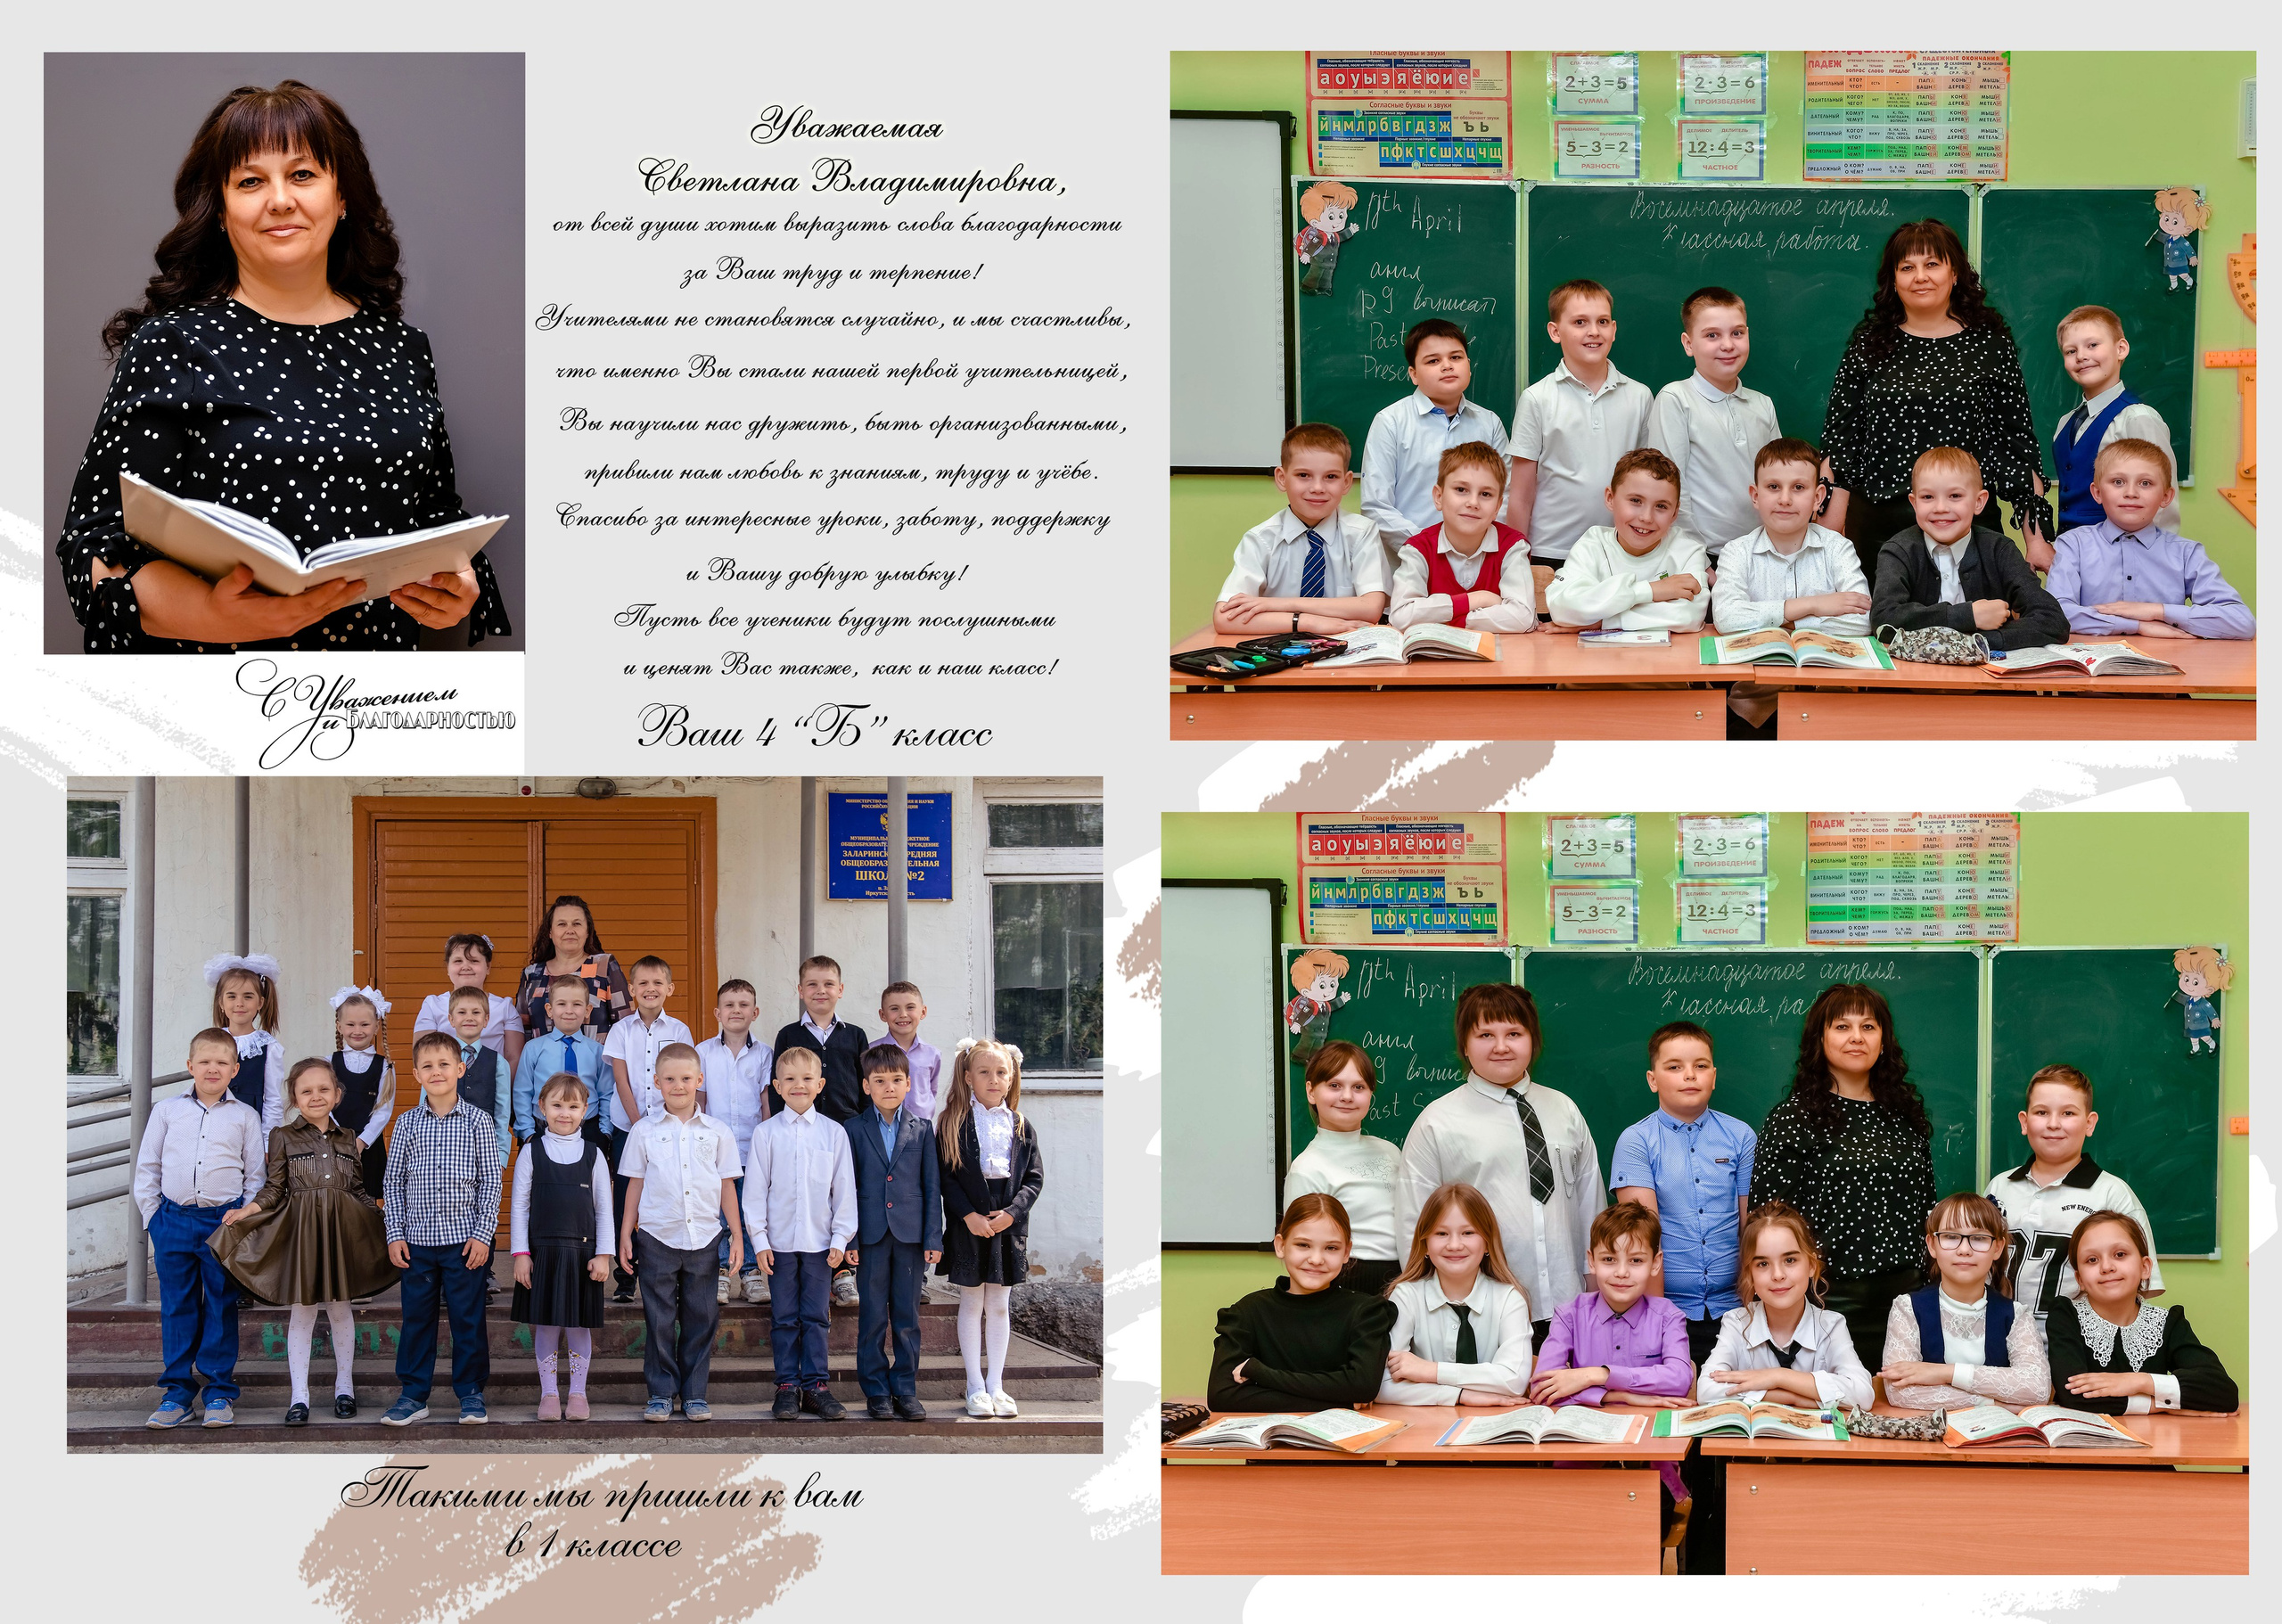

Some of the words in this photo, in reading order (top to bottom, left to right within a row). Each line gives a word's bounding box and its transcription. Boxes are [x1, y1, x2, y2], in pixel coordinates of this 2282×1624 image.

[1808, 59, 1843, 70] ПАДЕЖ
[1369, 101, 1404, 110] Согласные
[1405, 102, 1426, 110] буквы
[1578, 97, 1609, 105] СУММА
[1629, 190, 1802, 226] Восемнадцатое
[1411, 195, 1462, 239] April
[1391, 814, 1412, 822] буквы
[1810, 819, 1845, 829] ПАДЕЖ
[1694, 859, 1757, 867] ПРОИЗВЕДЕНИЕ
[1361, 867, 1397, 875] Согласные
[1628, 955, 1806, 992] Восемнадцатое
[1405, 963, 1456, 1007] April
[2061, 1204, 2076, 1212] NEW
